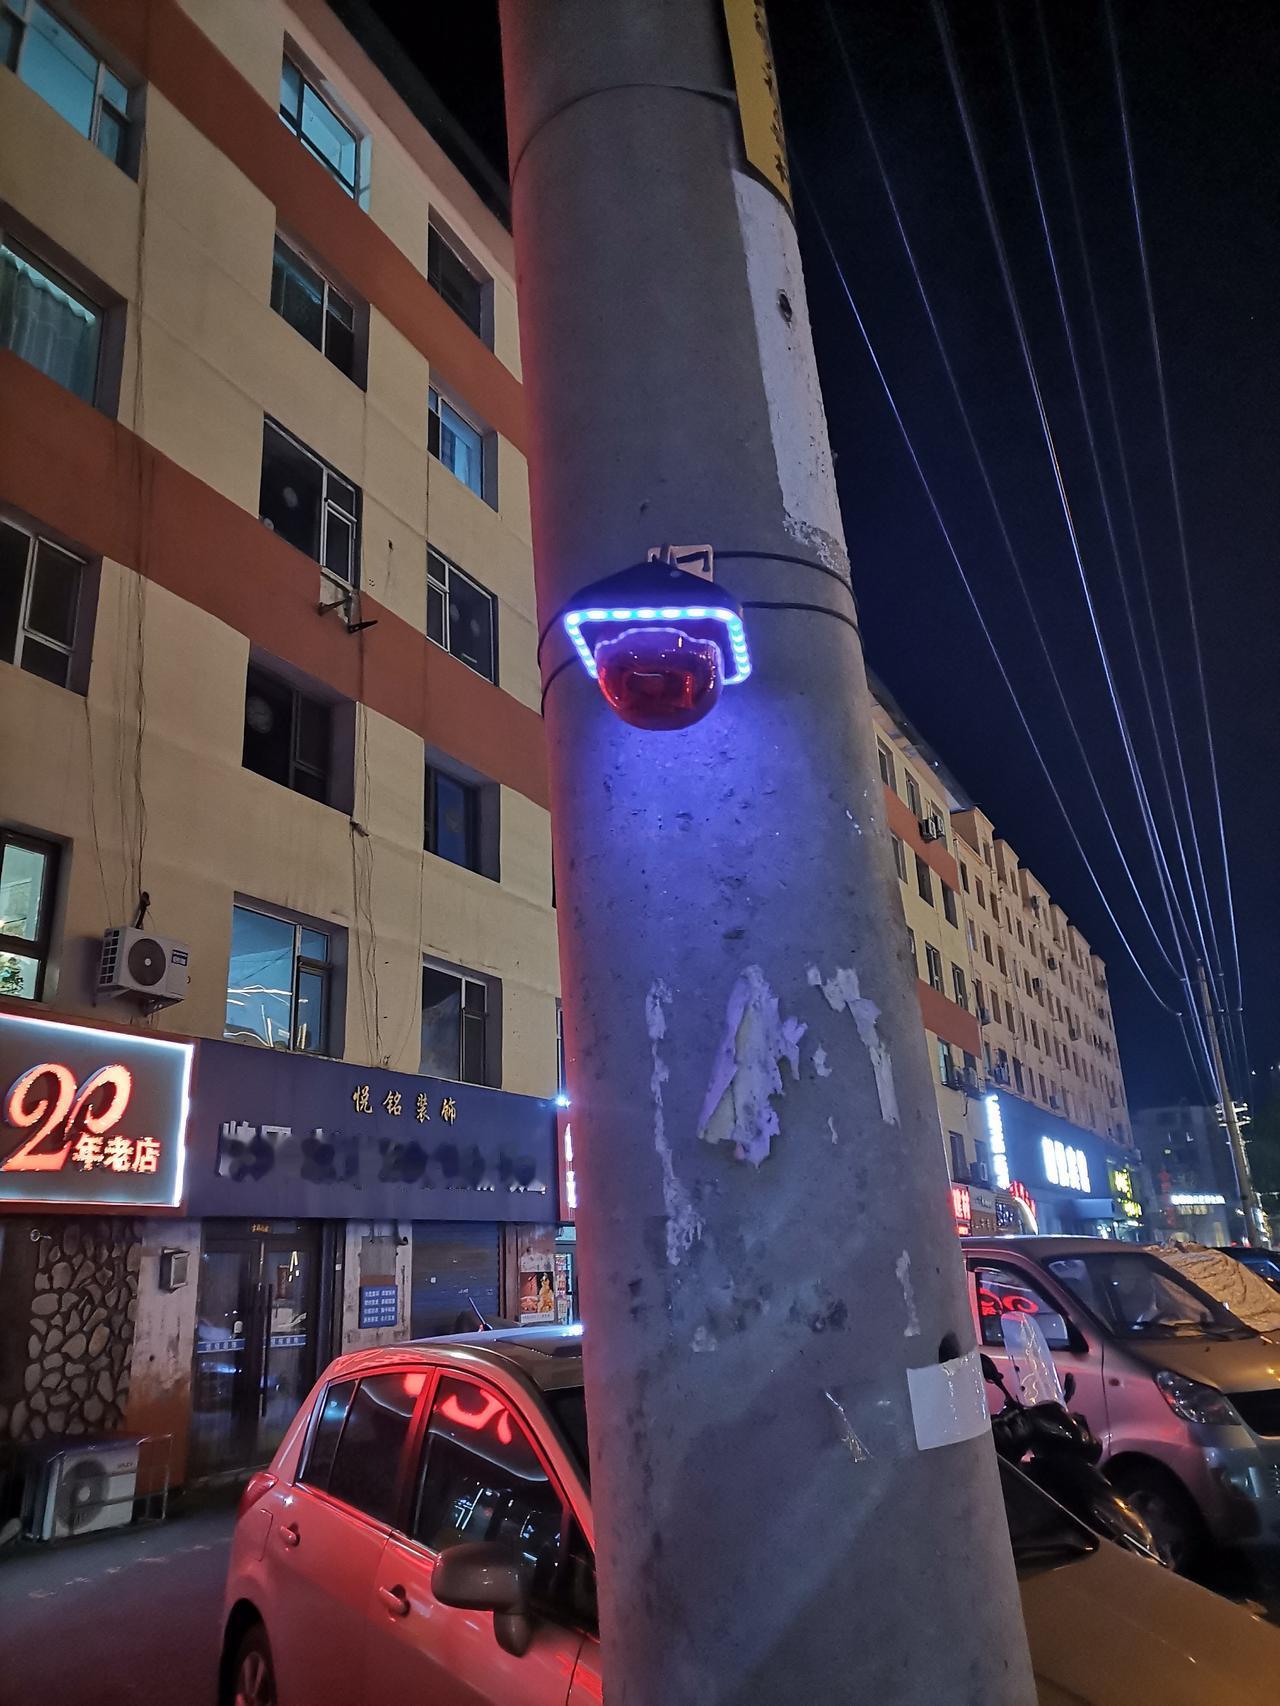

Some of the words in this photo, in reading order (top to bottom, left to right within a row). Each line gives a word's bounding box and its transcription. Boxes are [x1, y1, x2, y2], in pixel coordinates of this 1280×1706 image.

[1, 1063, 132, 1171] 20
[72, 1134, 161, 1173] 年老店
